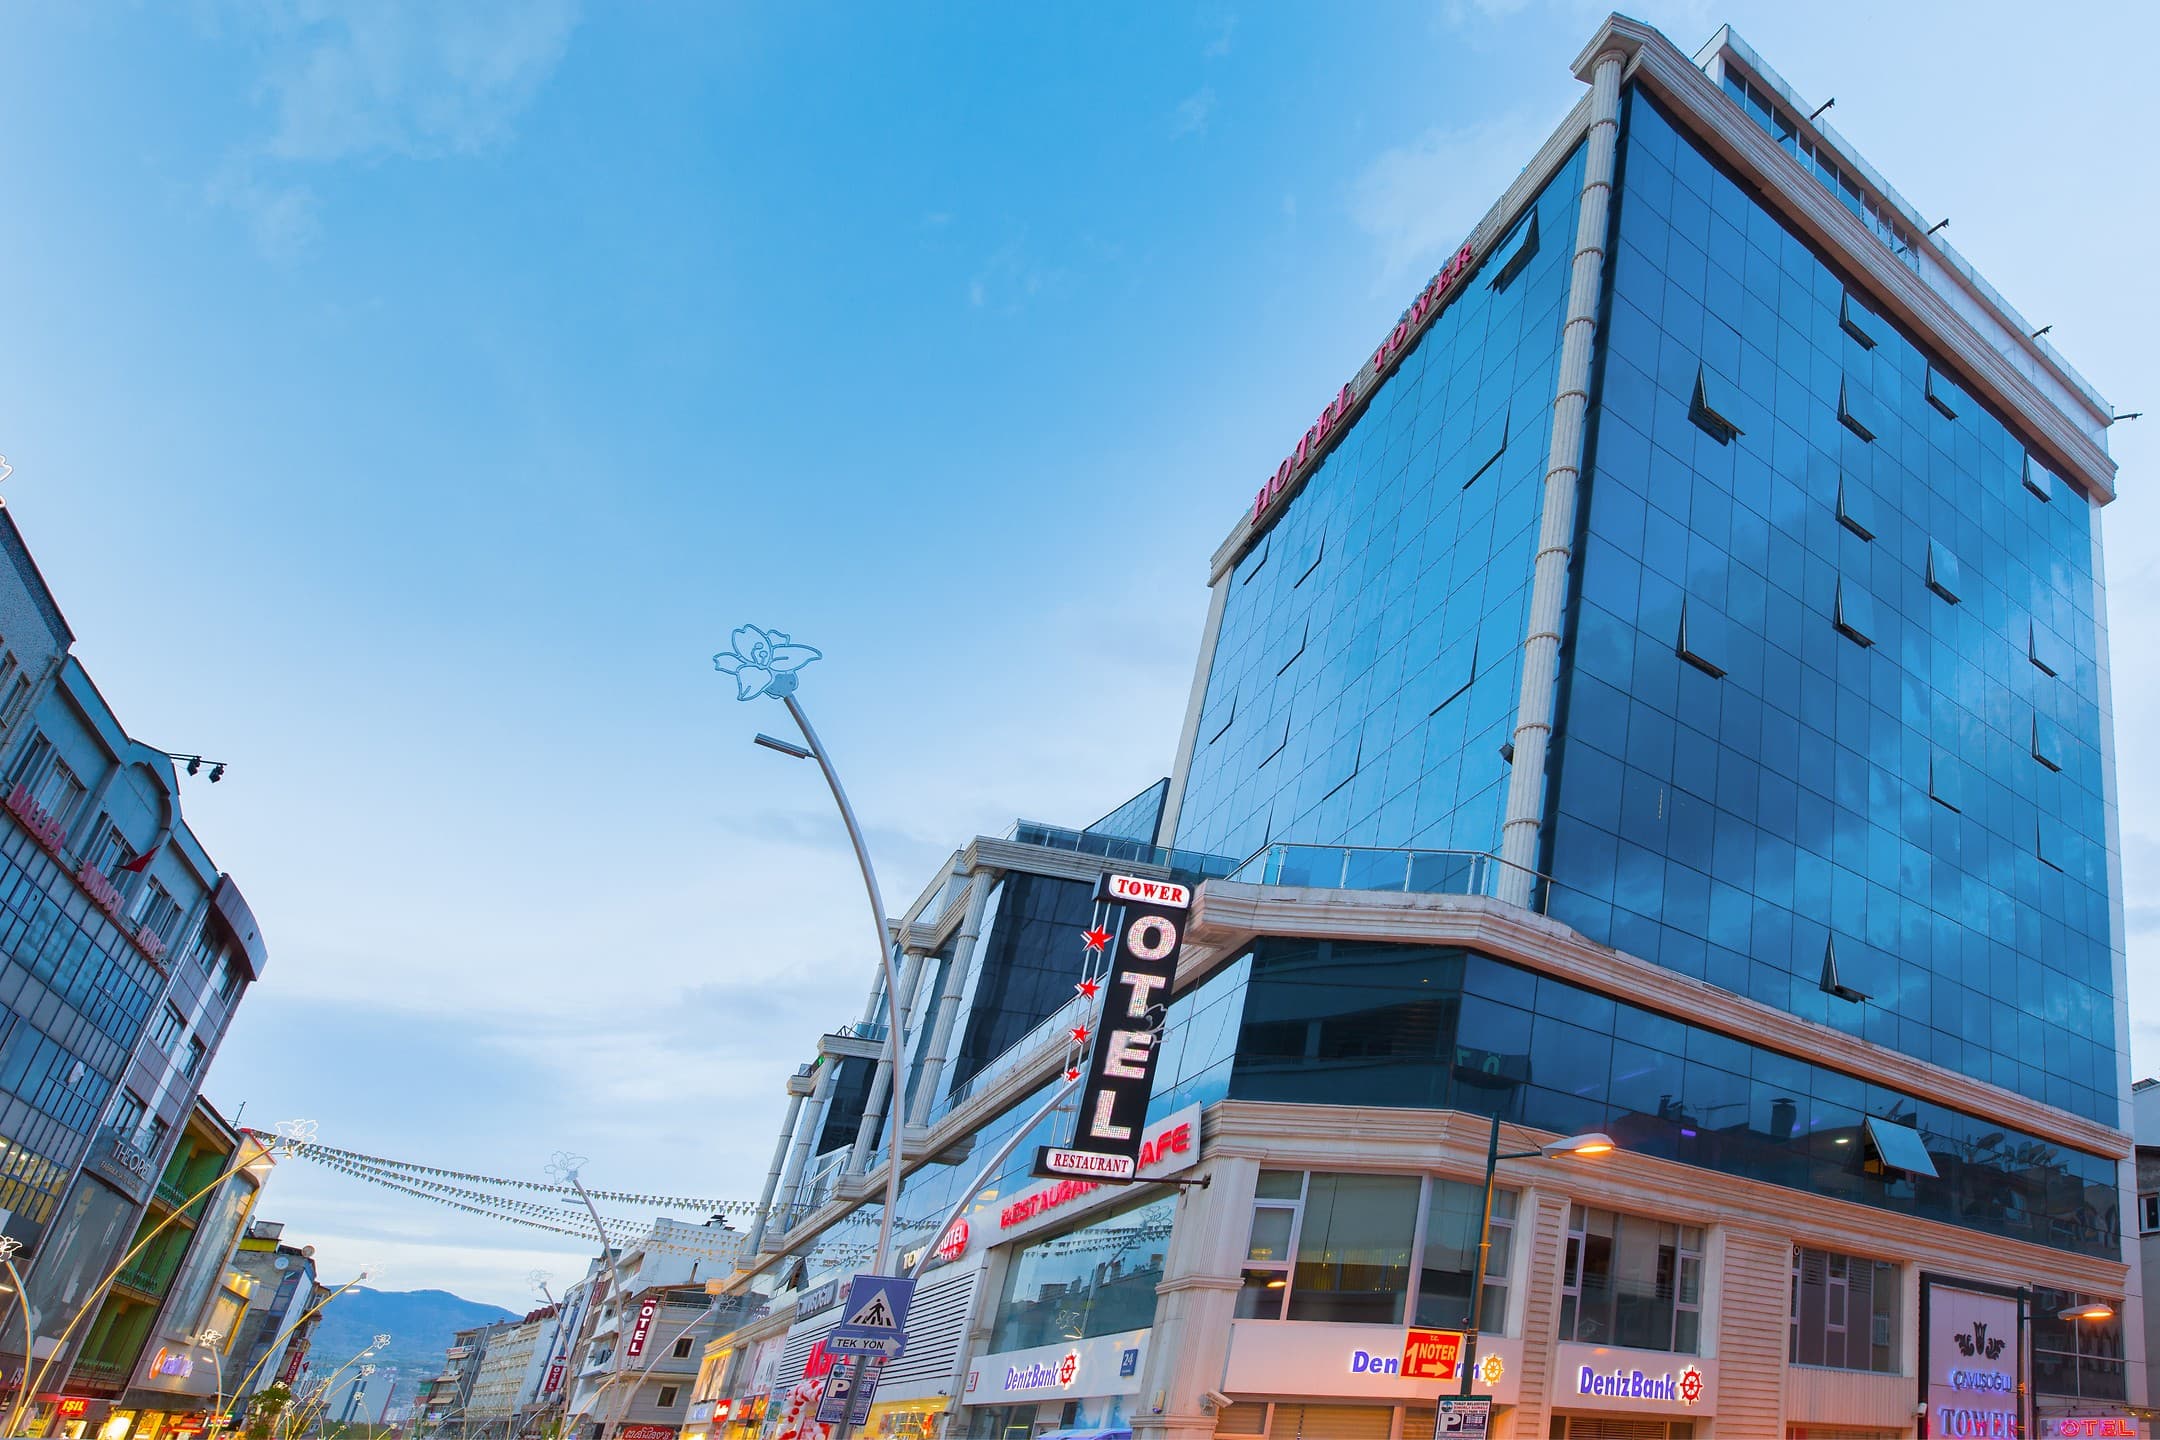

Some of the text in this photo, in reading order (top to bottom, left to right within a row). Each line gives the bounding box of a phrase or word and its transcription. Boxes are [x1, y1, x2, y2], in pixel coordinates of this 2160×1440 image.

[1251, 243, 1472, 525] HOTEL TOWER
[1118, 878, 1182, 903] TOWER
[1089, 915, 1177, 1140] OTEL
[1054, 1153, 1129, 1173] RESTAURANT
[1000, 1123, 1191, 1229] RESTAURAN AFE
[630, 1306, 653, 1353] OTEL
[837, 1338, 858, 1348] TEK
[1419, 1343, 1456, 1361] NOTER
[1123, 1353, 1134, 1366] 24
[1005, 1361, 1059, 1390] DenizBank
[1580, 1366, 1677, 1400] DenizBank
[1953, 1370, 2012, 1392] ÇAVUŞOĞLU
[827, 1379, 851, 1399] P
[1440, 1413, 1461, 1432] P
[1940, 1408, 2017, 1438] TOWER
